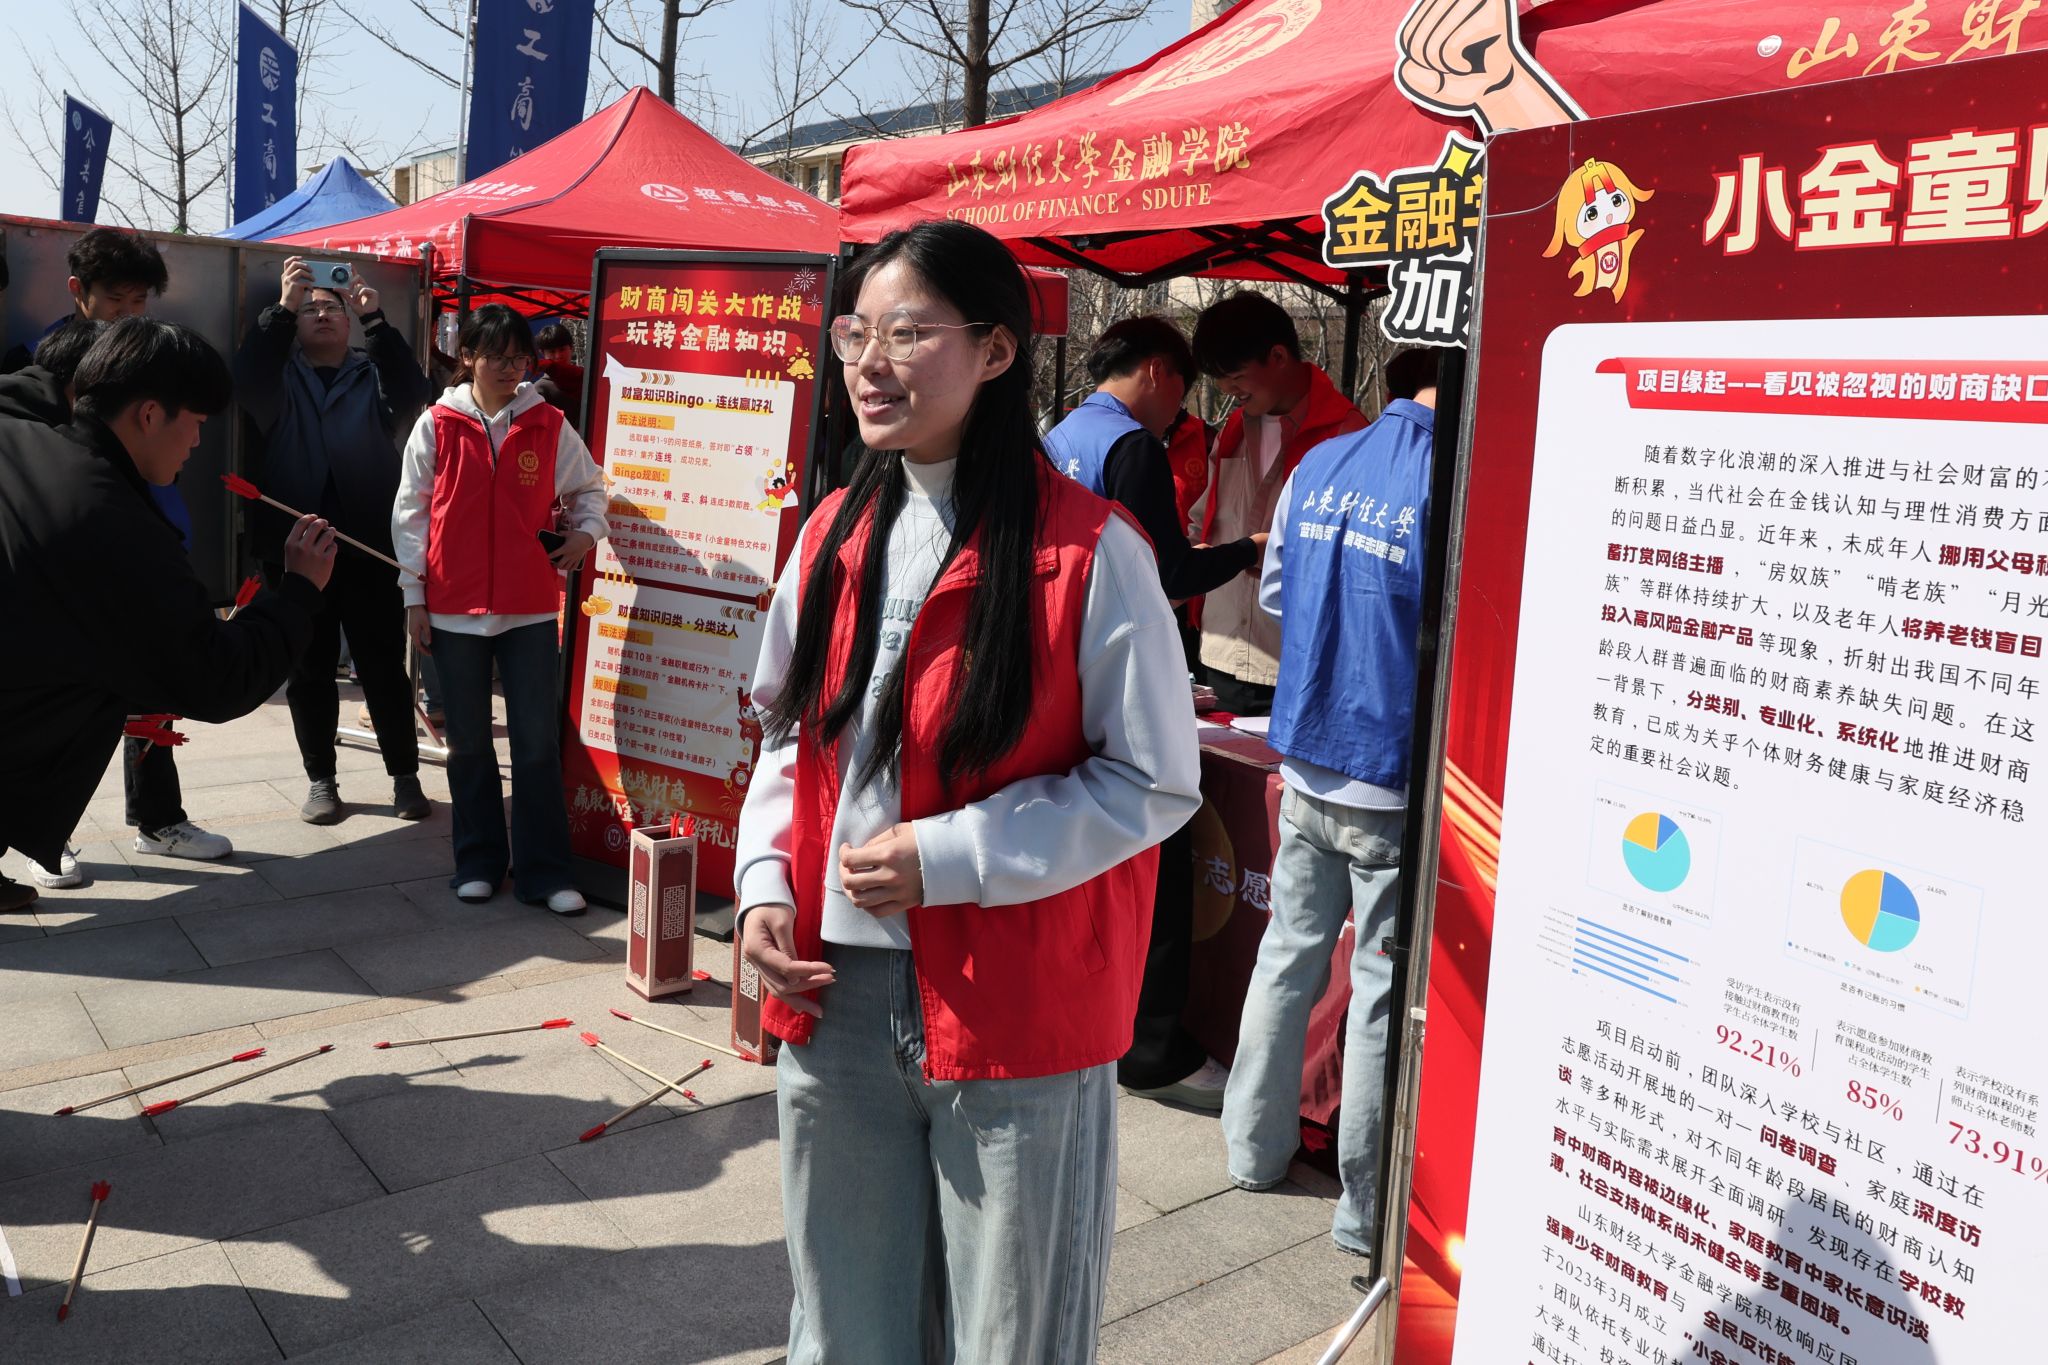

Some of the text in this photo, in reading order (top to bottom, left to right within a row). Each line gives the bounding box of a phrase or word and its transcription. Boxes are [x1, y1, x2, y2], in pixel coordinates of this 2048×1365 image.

[509, 28, 549, 157] 工商
[1012, 201, 1037, 221] OF
[1038, 192, 1120, 219] FINANCE
[1141, 183, 1213, 212] SDUFE
[1702, 125, 2048, 257] 小金童
[619, 286, 803, 321] 财商闯关大作战
[1394, 258, 1474, 334] 加
[625, 320, 788, 356] 玩转金融知识
[1589, 734, 1741, 792] 定的重要社会议题。
[1716, 1024, 1802, 1079] 92.21%
[1846, 1079, 1904, 1122] 85%
